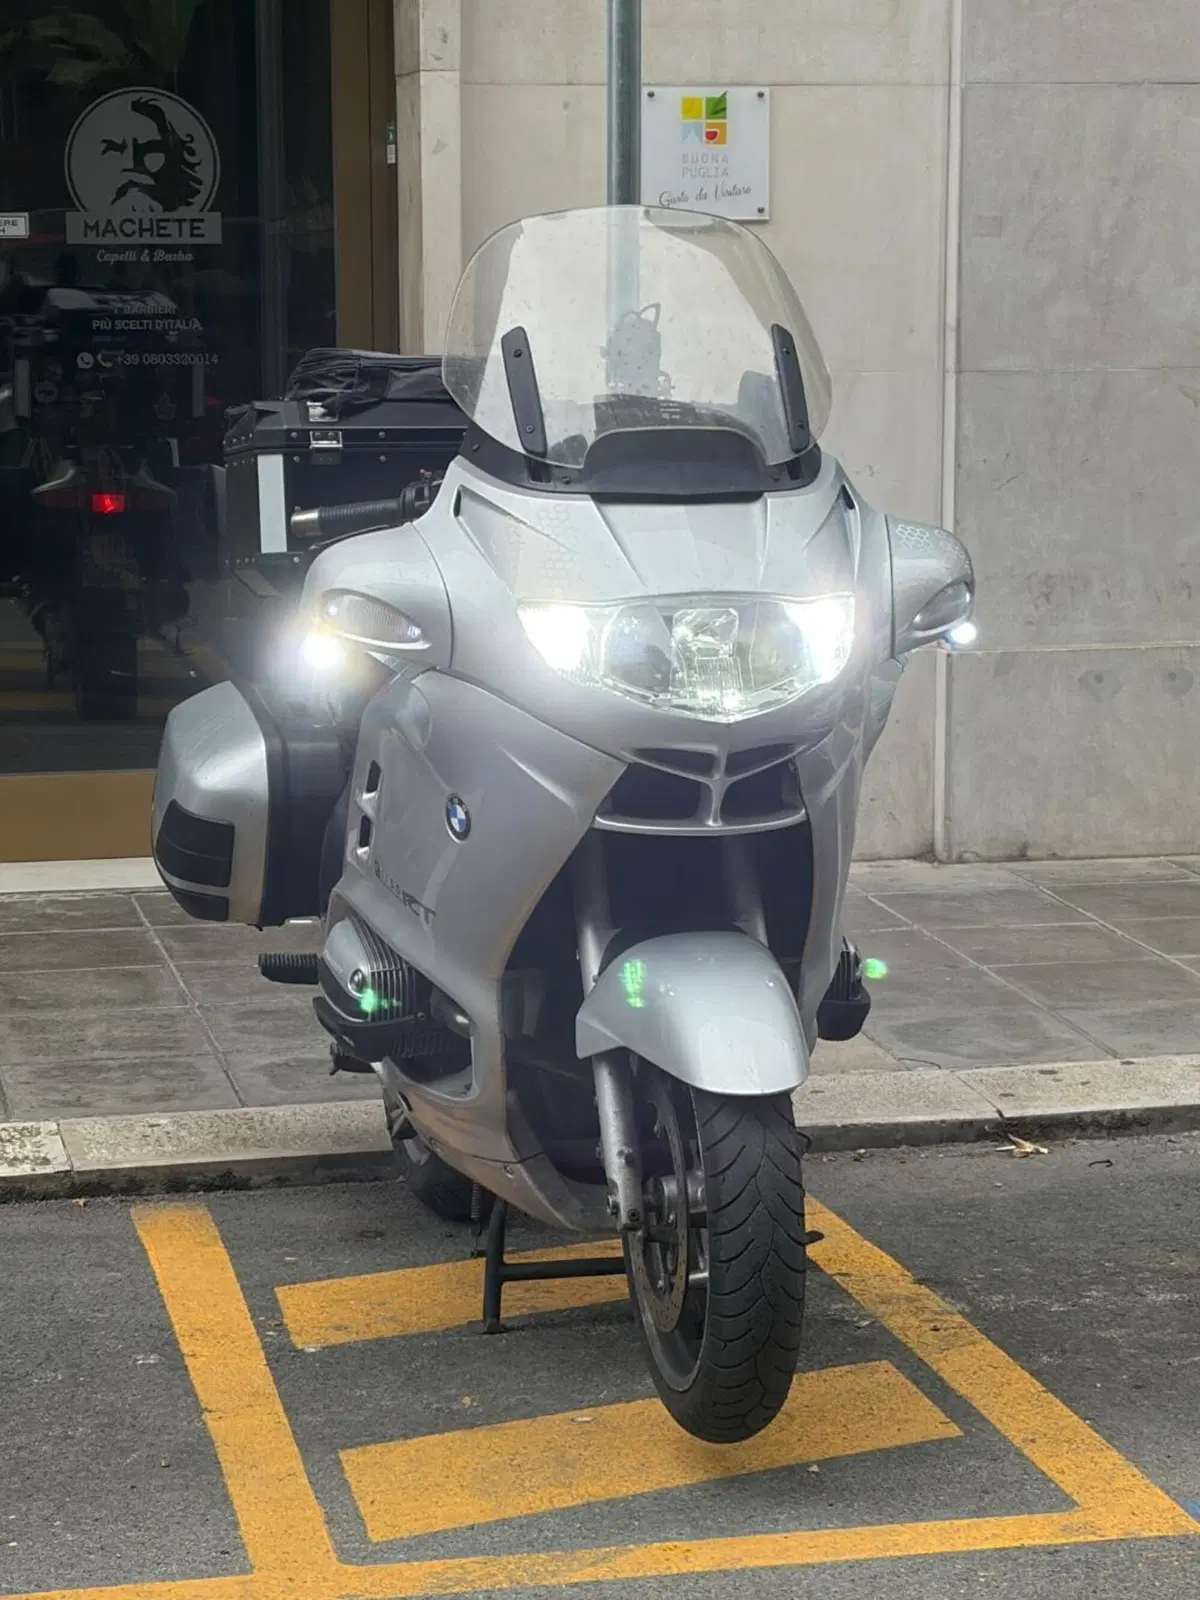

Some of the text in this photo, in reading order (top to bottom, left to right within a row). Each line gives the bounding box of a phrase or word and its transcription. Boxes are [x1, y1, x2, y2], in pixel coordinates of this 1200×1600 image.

[681, 152, 729, 165] BUONA
[681, 167, 729, 179] PUGLIA
[83, 218, 205, 239] MACHETE
[96, 248, 138, 265] Capelli
[140, 248, 151, 262] &
[92, 317, 112, 330] PIÙ
[115, 319, 152, 330] SCELTI
